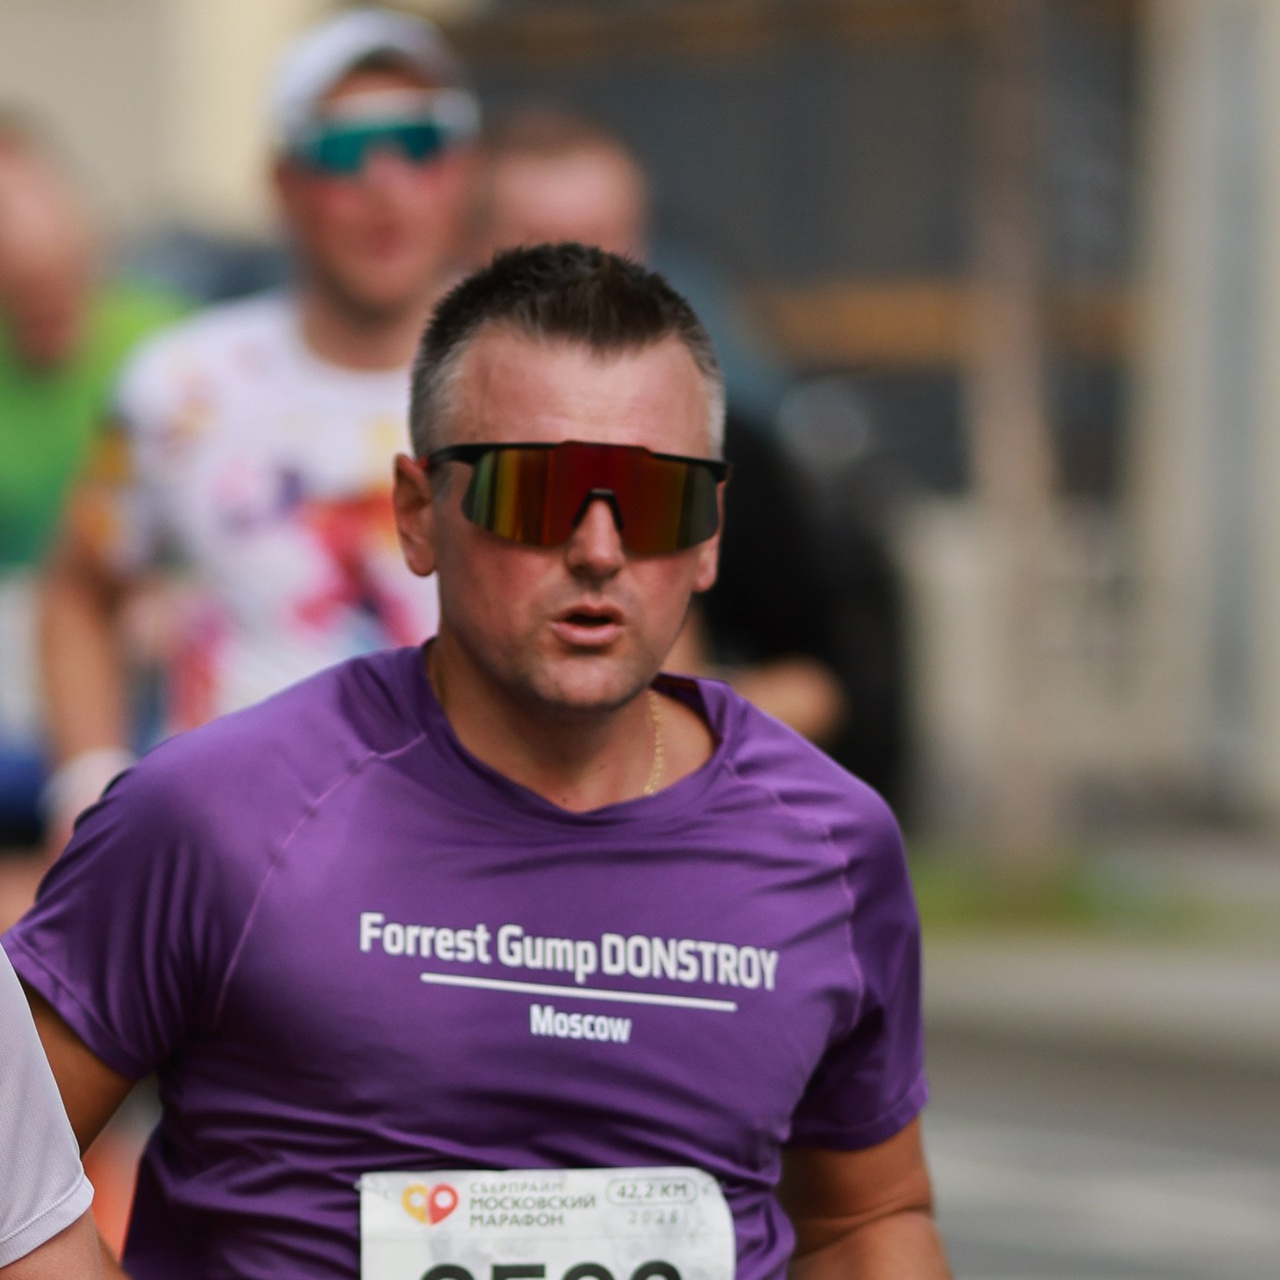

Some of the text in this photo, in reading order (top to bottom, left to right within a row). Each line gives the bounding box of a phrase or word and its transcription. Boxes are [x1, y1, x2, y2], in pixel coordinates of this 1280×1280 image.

[359, 912, 779, 991] Forrest Gump DONSTROY
[530, 1004, 632, 1043] Moscow
[469, 1193, 596, 1211] МОСКОВСКИЙ
[469, 1214, 564, 1228] МАРАФОН
